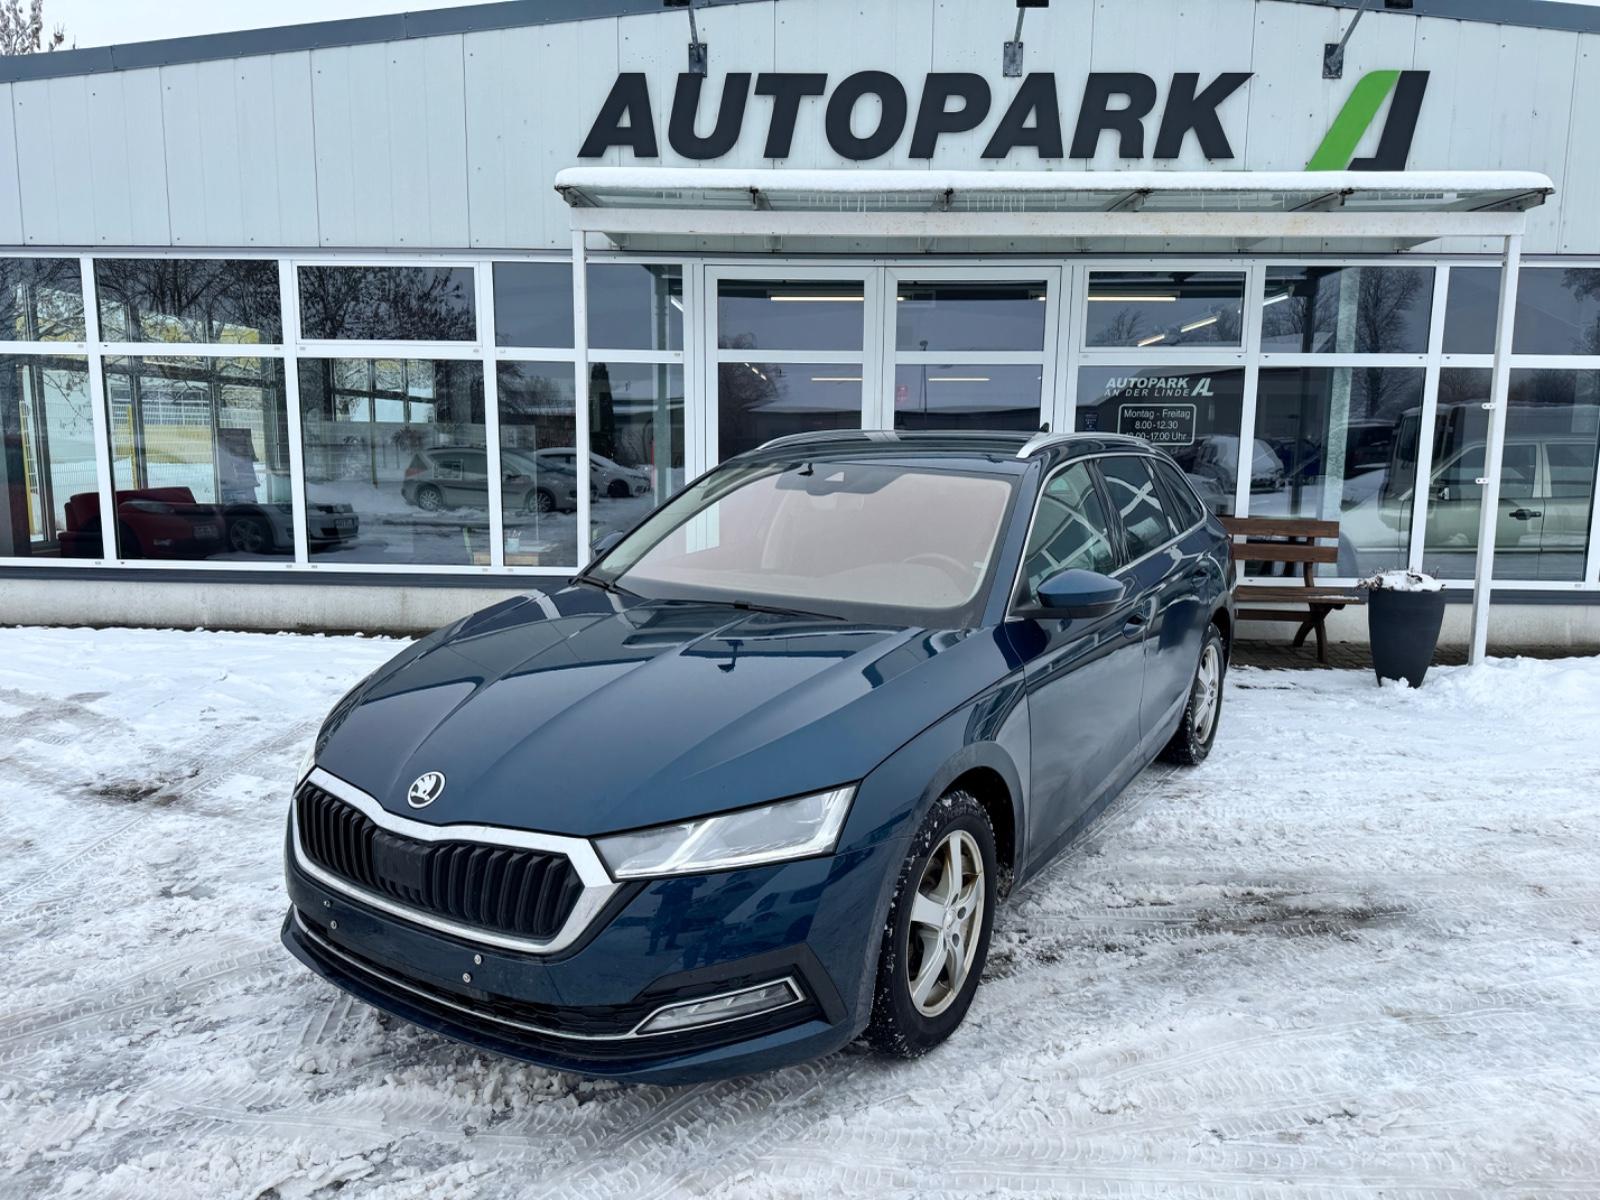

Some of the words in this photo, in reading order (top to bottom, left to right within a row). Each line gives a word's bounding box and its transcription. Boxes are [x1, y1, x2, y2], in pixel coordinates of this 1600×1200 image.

[577, 73, 1254, 159] AUTOPARK
[1105, 378, 1189, 388] AUTOPARK
[1124, 409, 1154, 419] Montag
[1162, 409, 1190, 419] Freitag
[1171, 432, 1186, 440] Uhr
